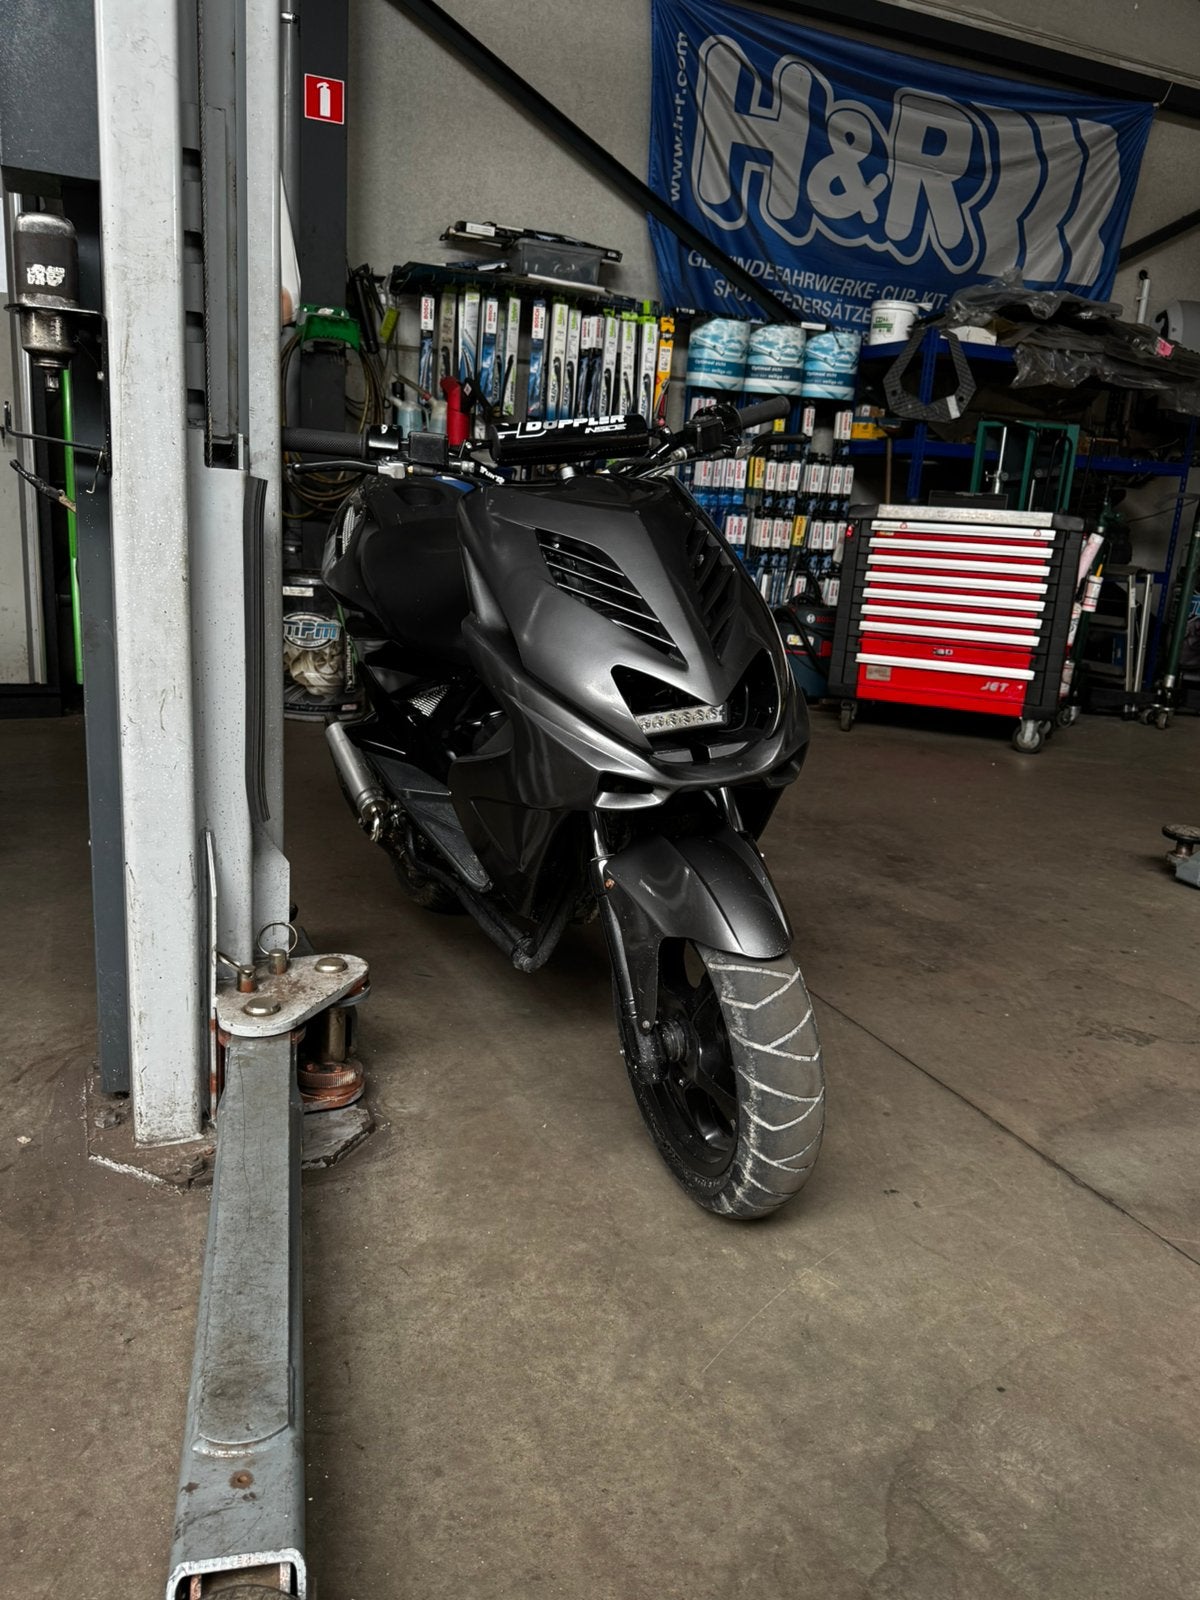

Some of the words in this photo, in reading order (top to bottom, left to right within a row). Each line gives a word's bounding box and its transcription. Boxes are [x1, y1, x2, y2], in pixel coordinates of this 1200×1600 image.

[694, 35, 984, 264] H&R
[688, 249, 877, 299] GENDEFAHRWERKE
[713, 279, 871, 324] SPOFEDERSÄTZE
[525, 415, 625, 432] DOPPLER
